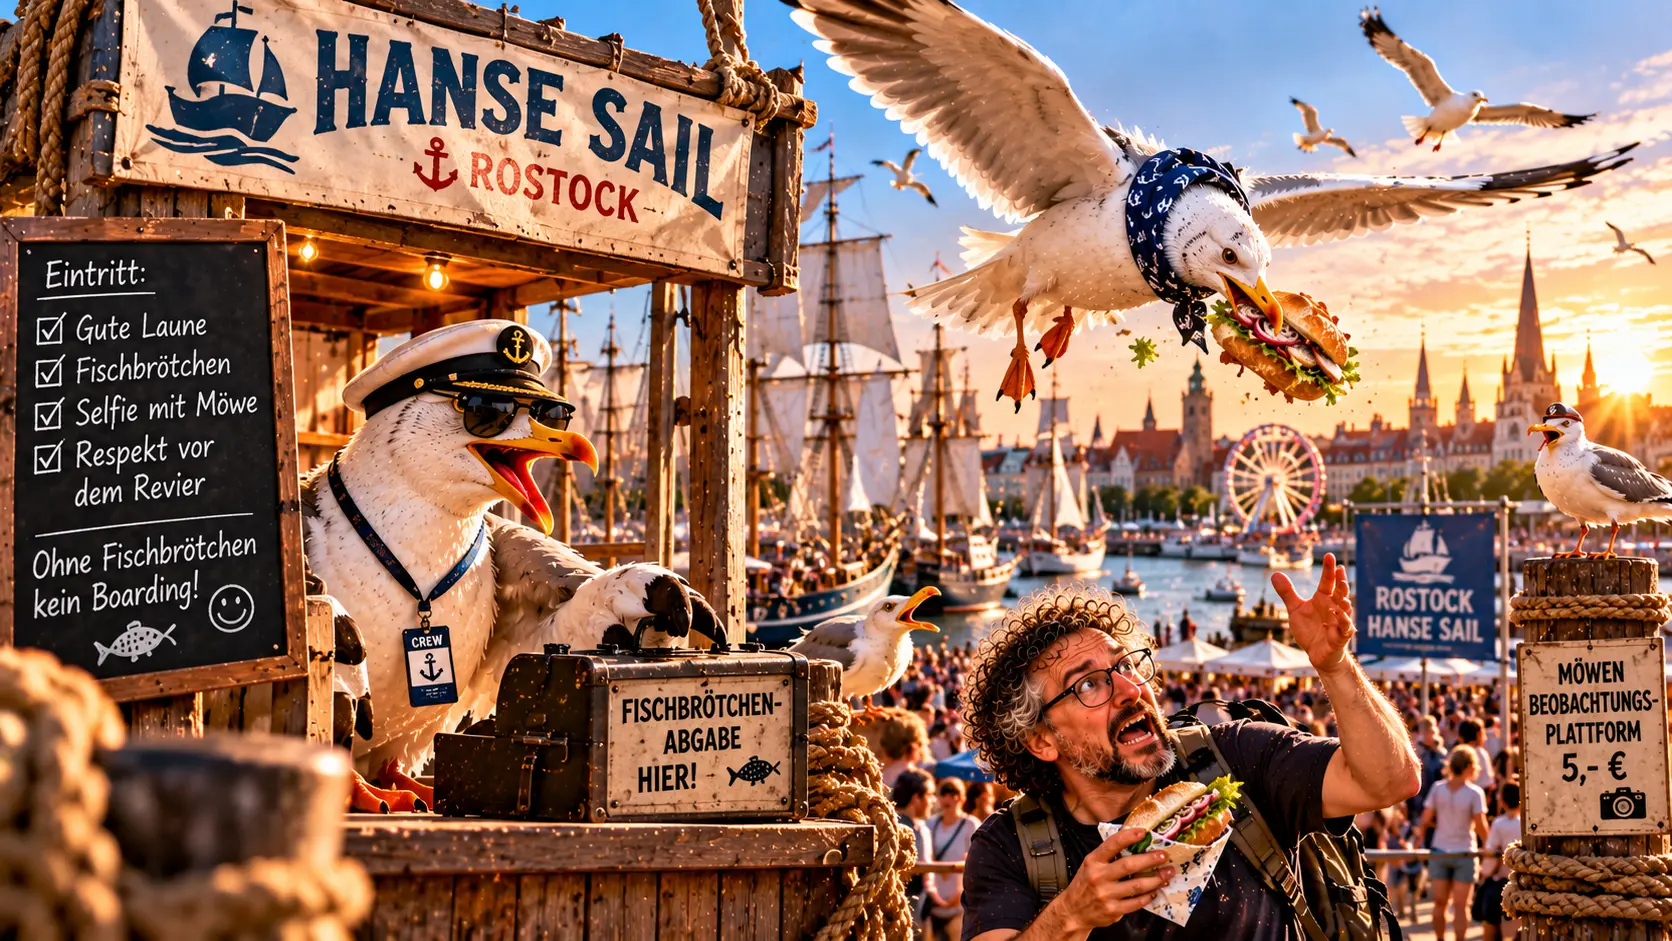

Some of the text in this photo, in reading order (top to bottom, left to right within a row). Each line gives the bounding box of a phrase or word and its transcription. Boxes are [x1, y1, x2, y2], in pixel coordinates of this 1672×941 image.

[313, 29, 724, 220] HANSE SAIL
[469, 152, 640, 223] ROSTOCK
[45, 259, 146, 289] Eintritt:
[75, 312, 207, 344] Gute Laune
[76, 349, 231, 384] Fischbrötchen
[75, 390, 258, 430] Selfie mit Möwe
[75, 434, 215, 474] Respekt vor
[74, 472, 206, 507] dem Revier
[32, 530, 257, 579] Ohne Fischbrötchen
[33, 569, 199, 619] kein Boarding!
[1375, 586, 1474, 614] ROSTOCK
[411, 634, 443, 648] CREW
[1367, 615, 1484, 643] HANSE SAIL
[1558, 657, 1625, 685] MÖWEN
[622, 689, 782, 724] FISCHBRÖTCHEN-
[1529, 690, 1659, 715] BEOBACHTUNGS-
[663, 726, 741, 754] ABGABE
[1545, 720, 1642, 745] PLATTFORM
[638, 762, 697, 793] HIER!
[1561, 751, 1627, 786] 5,- €
